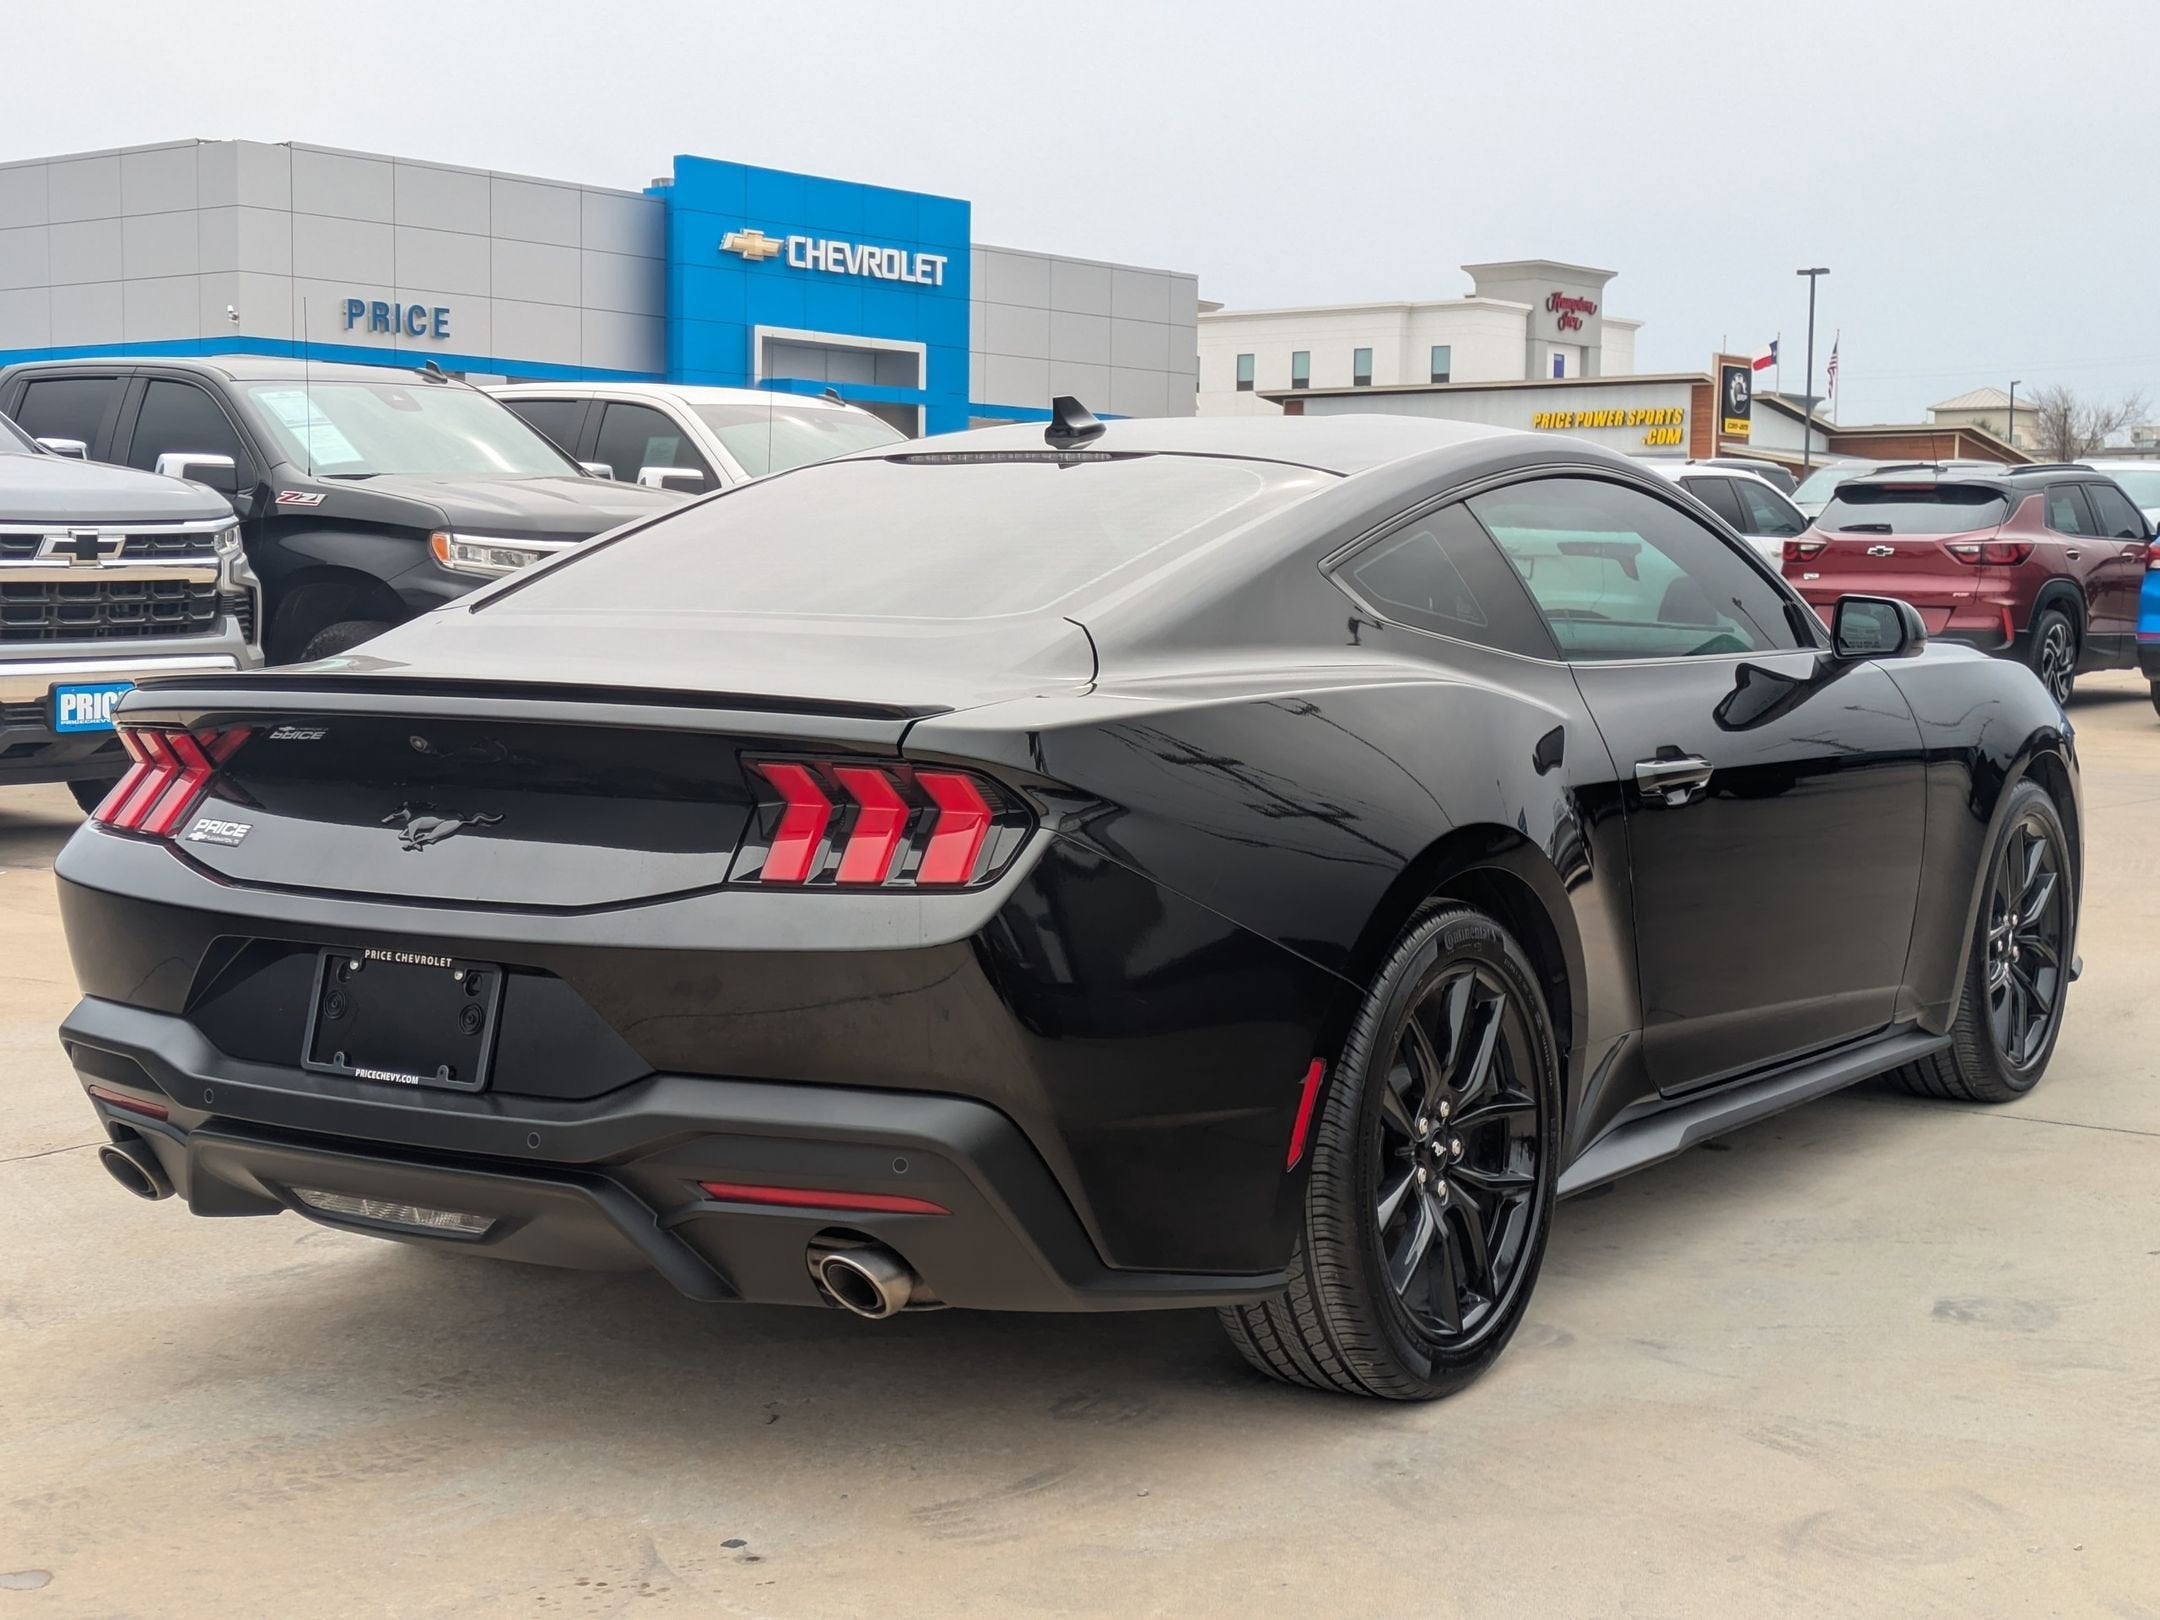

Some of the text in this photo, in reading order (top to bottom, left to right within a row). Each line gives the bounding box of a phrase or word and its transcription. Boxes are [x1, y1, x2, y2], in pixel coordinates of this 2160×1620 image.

[786, 235, 948, 286] CHEVROLET
[343, 298, 450, 338] PRICE
[1533, 408, 1684, 429] PRICE POWER SPORTS
[1642, 427, 1683, 446] .COM
[60, 691, 123, 721] PRIC
[193, 818, 252, 838] PRICE
[364, 949, 453, 968] PRICE CHEVROLET
[355, 1068, 419, 1085] PRICECHEVY.COM
